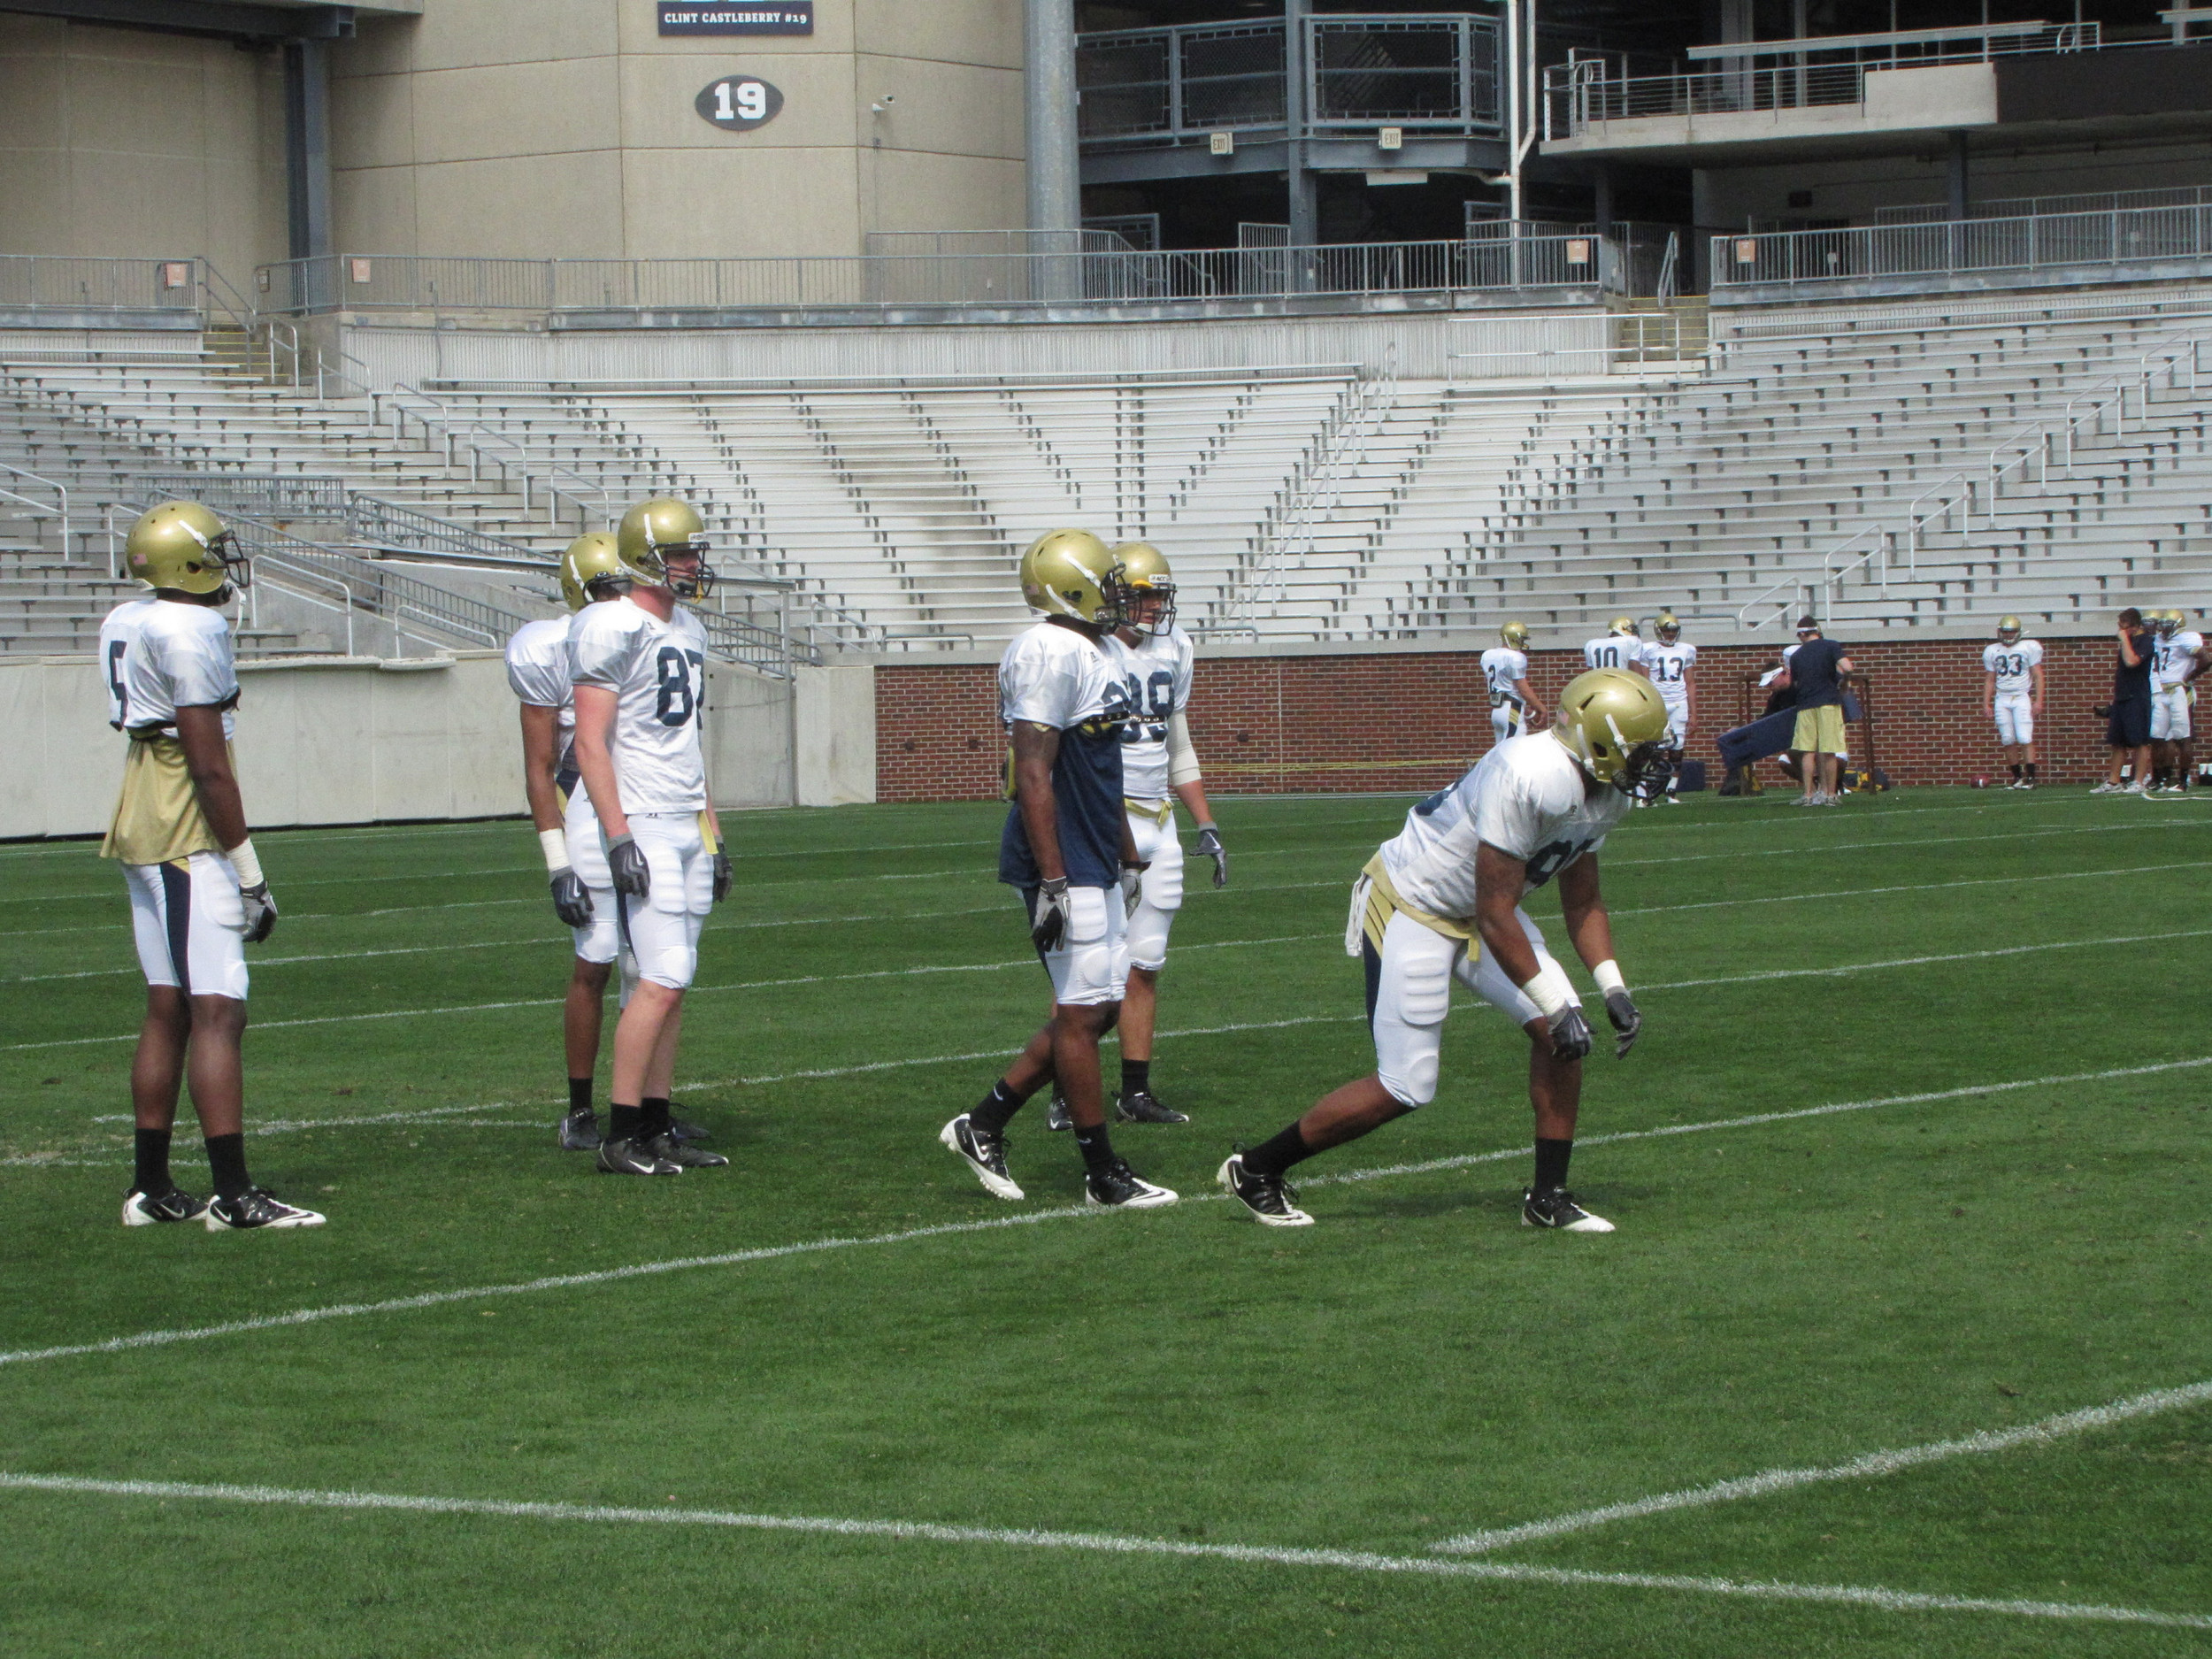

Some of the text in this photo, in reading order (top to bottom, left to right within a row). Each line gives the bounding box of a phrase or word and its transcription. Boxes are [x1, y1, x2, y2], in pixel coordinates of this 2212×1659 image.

[664, 12, 807, 25] CLINT CASTLEBERRY #19
[714, 82, 766, 120] 19
[1212, 138, 1225, 150] EXIT
[1385, 133, 1400, 146] EXIT
[1656, 657, 1684, 681] 13
[1994, 653, 2023, 677] 33
[656, 646, 705, 730] 87
